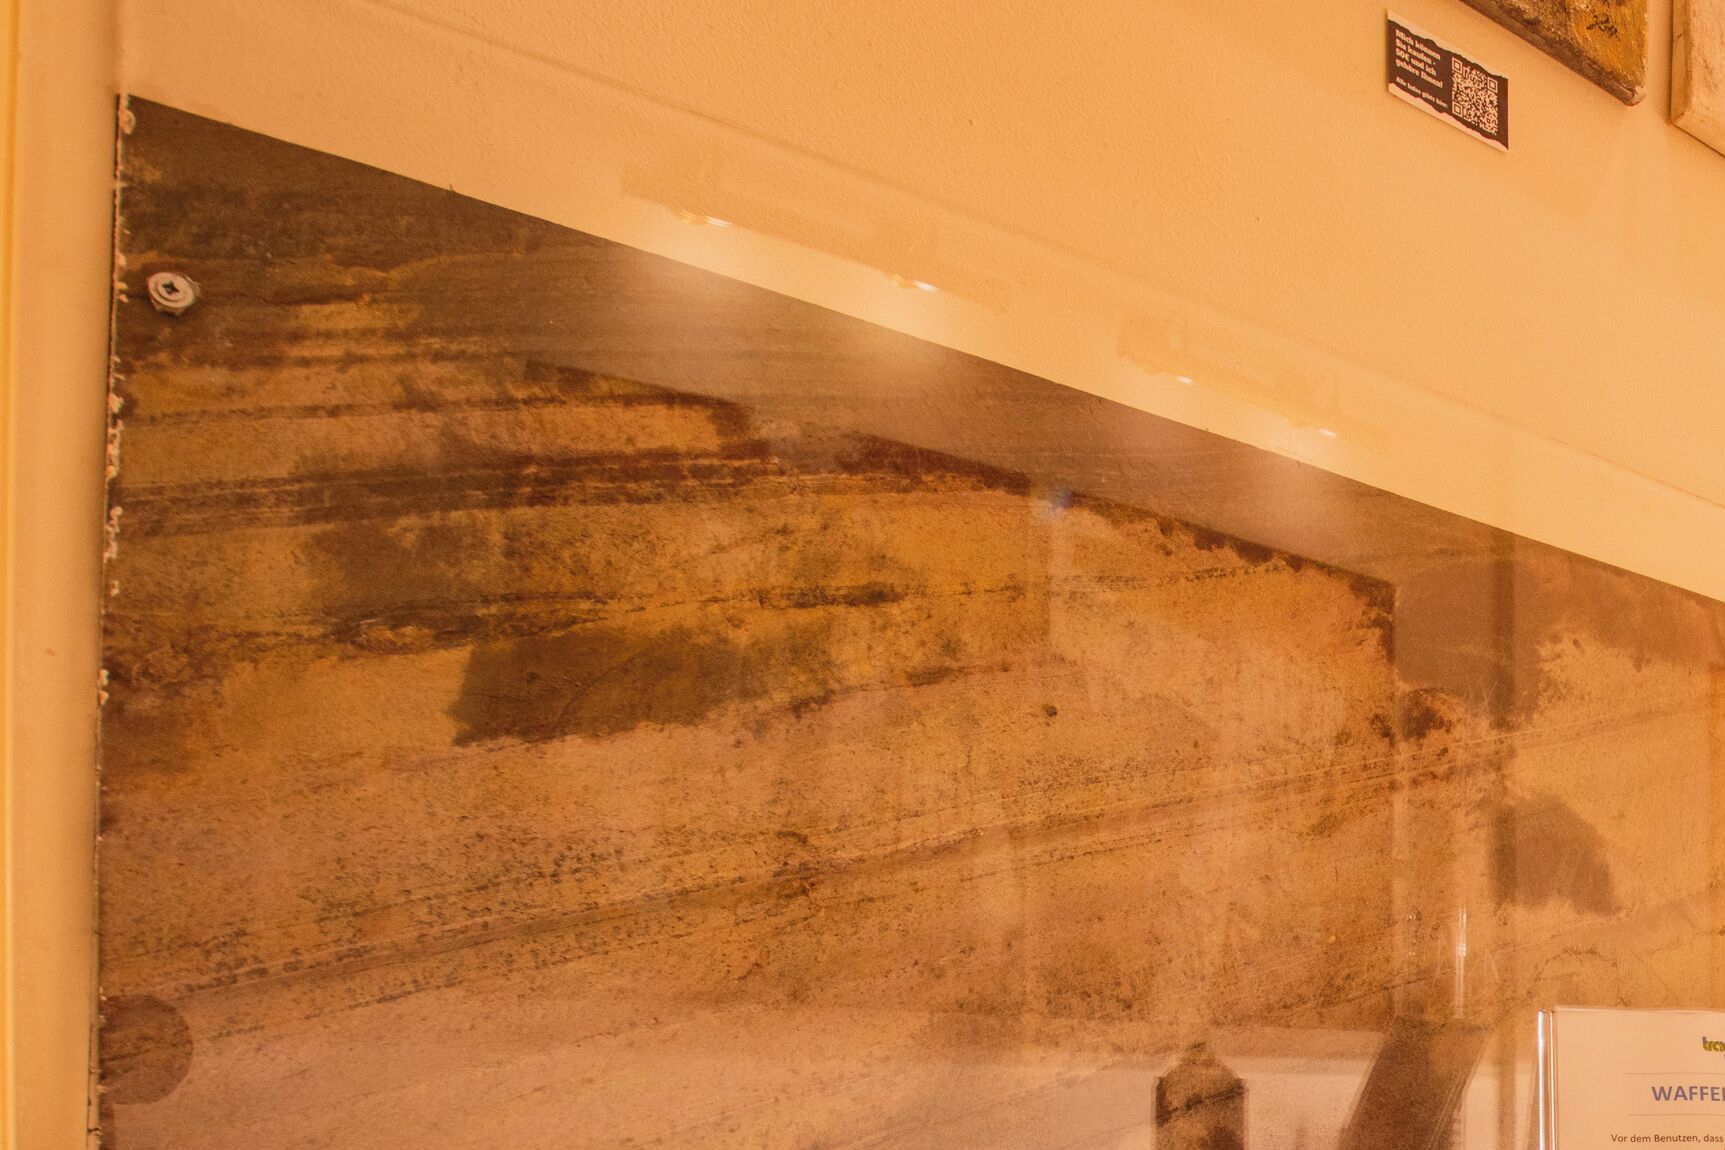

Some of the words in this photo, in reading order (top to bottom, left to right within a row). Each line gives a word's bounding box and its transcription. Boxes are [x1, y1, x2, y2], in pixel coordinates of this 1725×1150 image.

[1396, 29, 1414, 46] Mich
[1396, 38, 1407, 51] Sie
[1611, 1134, 1627, 1143] Vor
[1630, 1134, 1651, 1143] dem
[1654, 1134, 1701, 1144] Benutzen,
[1703, 1134, 1724, 1143] dass
